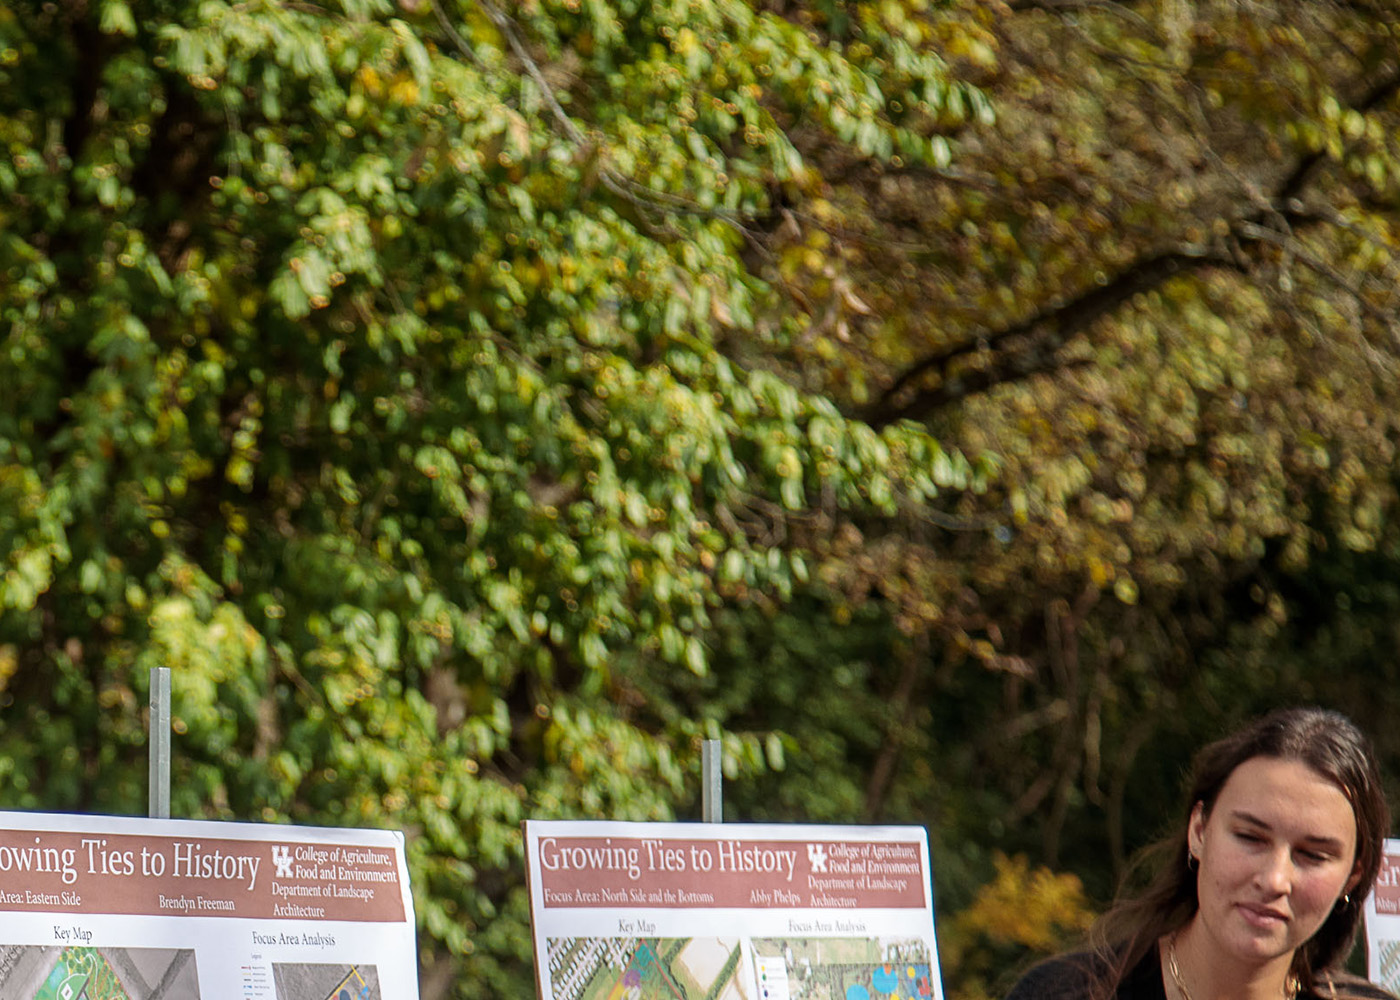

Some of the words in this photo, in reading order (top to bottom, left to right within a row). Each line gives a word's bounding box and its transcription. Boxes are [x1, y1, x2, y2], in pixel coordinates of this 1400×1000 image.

[295, 846, 328, 864] College
[329, 847, 340, 861] of
[340, 849, 392, 866] Agriculture,
[540, 838, 640, 880] Growing
[641, 839, 685, 871] Ties
[690, 845, 712, 871] to
[717, 840, 796, 881] History
[828, 843, 859, 859] College
[861, 844, 871, 859] of
[871, 844, 917, 860] Agriculture,
[81, 839, 134, 875] Ties
[140, 846, 165, 876] to
[172, 842, 261, 890] History
[829, 858, 849, 874] Food
[851, 859, 867, 874] and
[867, 860, 920, 874] Environment
[295, 865, 318, 880] Food
[319, 867, 336, 880] and
[337, 867, 397, 883] Environment
[807, 874, 854, 892] Department
[855, 874, 865, 889] of
[866, 874, 907, 892] Landscape
[25, 890, 60, 904] Eastern
[61, 891, 80, 905] Side
[271, 881, 321, 900] Department
[322, 882, 331, 896] of
[332, 883, 374, 902] Landscape
[544, 888, 572, 903] Focus
[575, 888, 599, 902] Area:
[601, 887, 628, 902] North
[629, 888, 646, 902] Side
[648, 888, 662, 902] and
[663, 888, 676, 903] the
[677, 888, 714, 903] Bottoms
[749, 889, 771, 906] Abby
[773, 888, 800, 906] Phelps
[810, 893, 856, 907] Architecture
[158, 894, 195, 913] Brendyn
[196, 895, 235, 910] Freeman
[273, 902, 324, 917] Architecture
[618, 919, 634, 935] Key
[637, 919, 656, 935] Map
[788, 918, 812, 932] Focus
[814, 919, 832, 931] Area
[834, 920, 866, 931] Analysis
[53, 925, 70, 943] Key
[72, 926, 92, 944] Map
[251, 930, 276, 944] Focus
[278, 932, 299, 944] Area
[301, 932, 335, 949] Analysis
